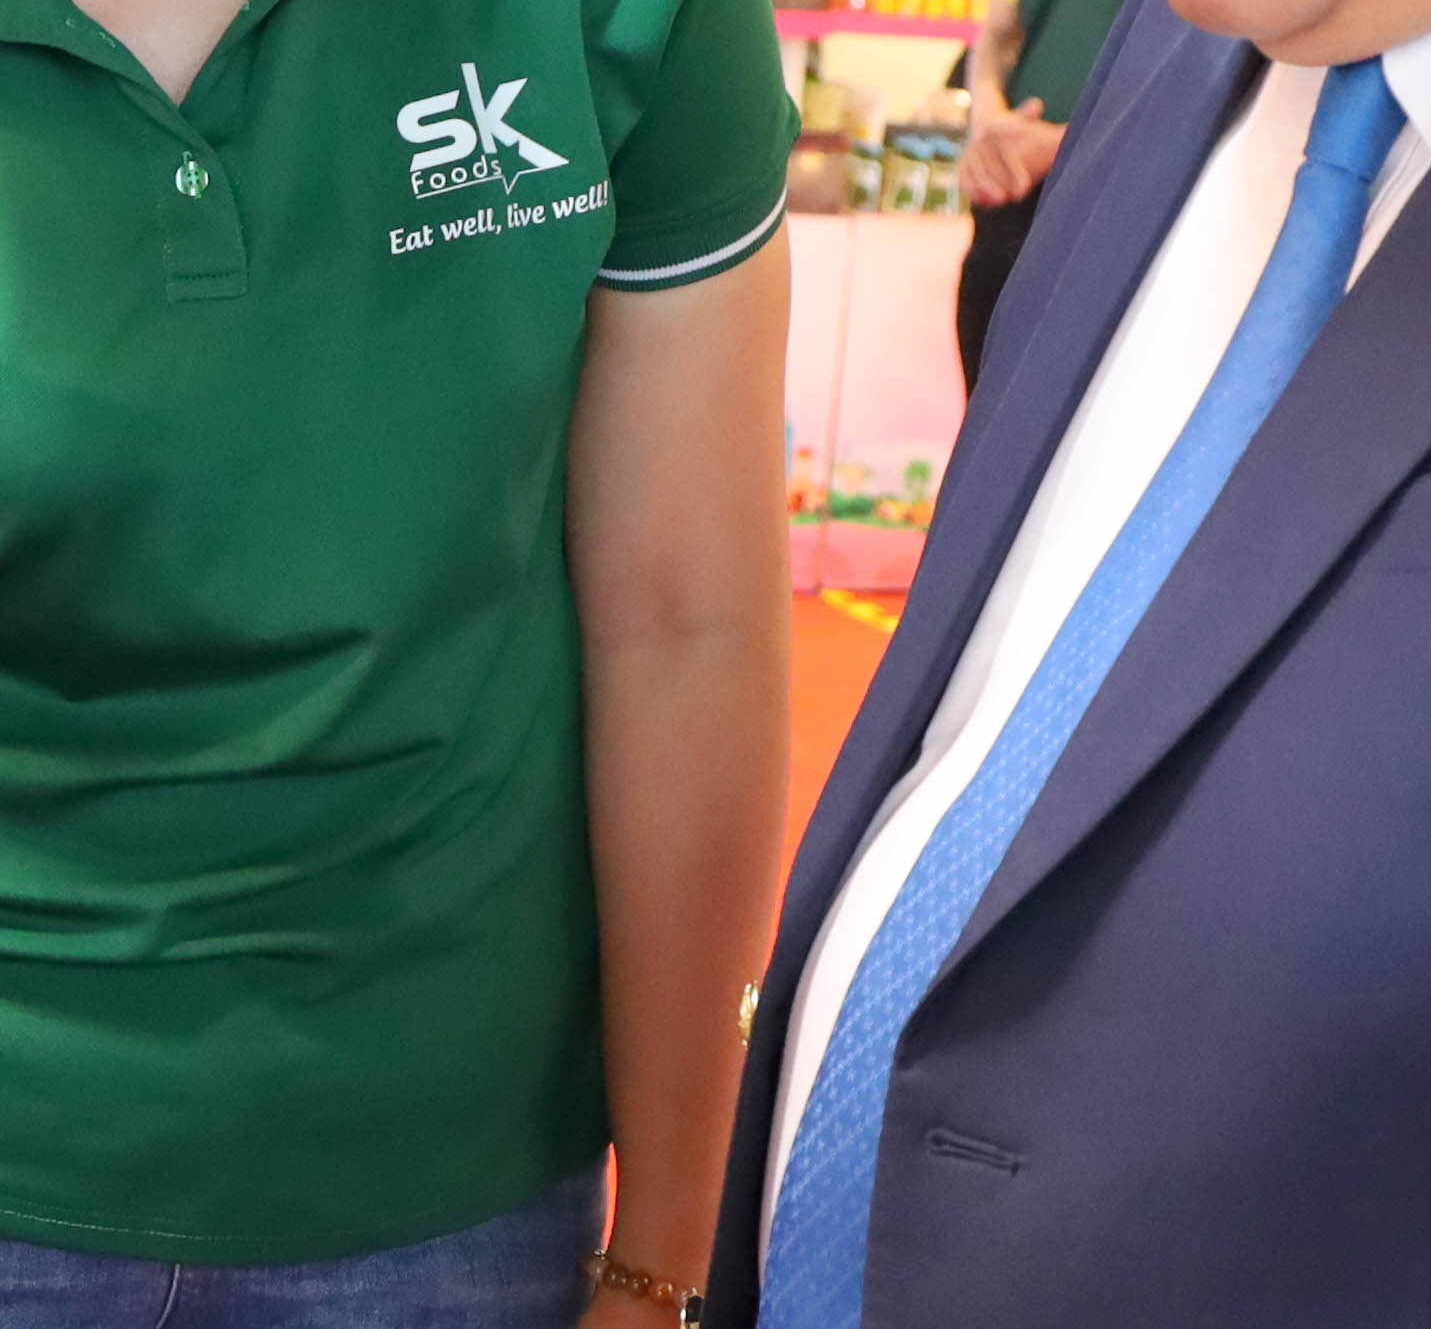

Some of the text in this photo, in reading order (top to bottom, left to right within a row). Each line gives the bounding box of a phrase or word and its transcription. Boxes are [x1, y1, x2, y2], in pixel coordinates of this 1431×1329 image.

[410, 155, 503, 195] Foods
[389, 180, 609, 255] Eat well, live well!
